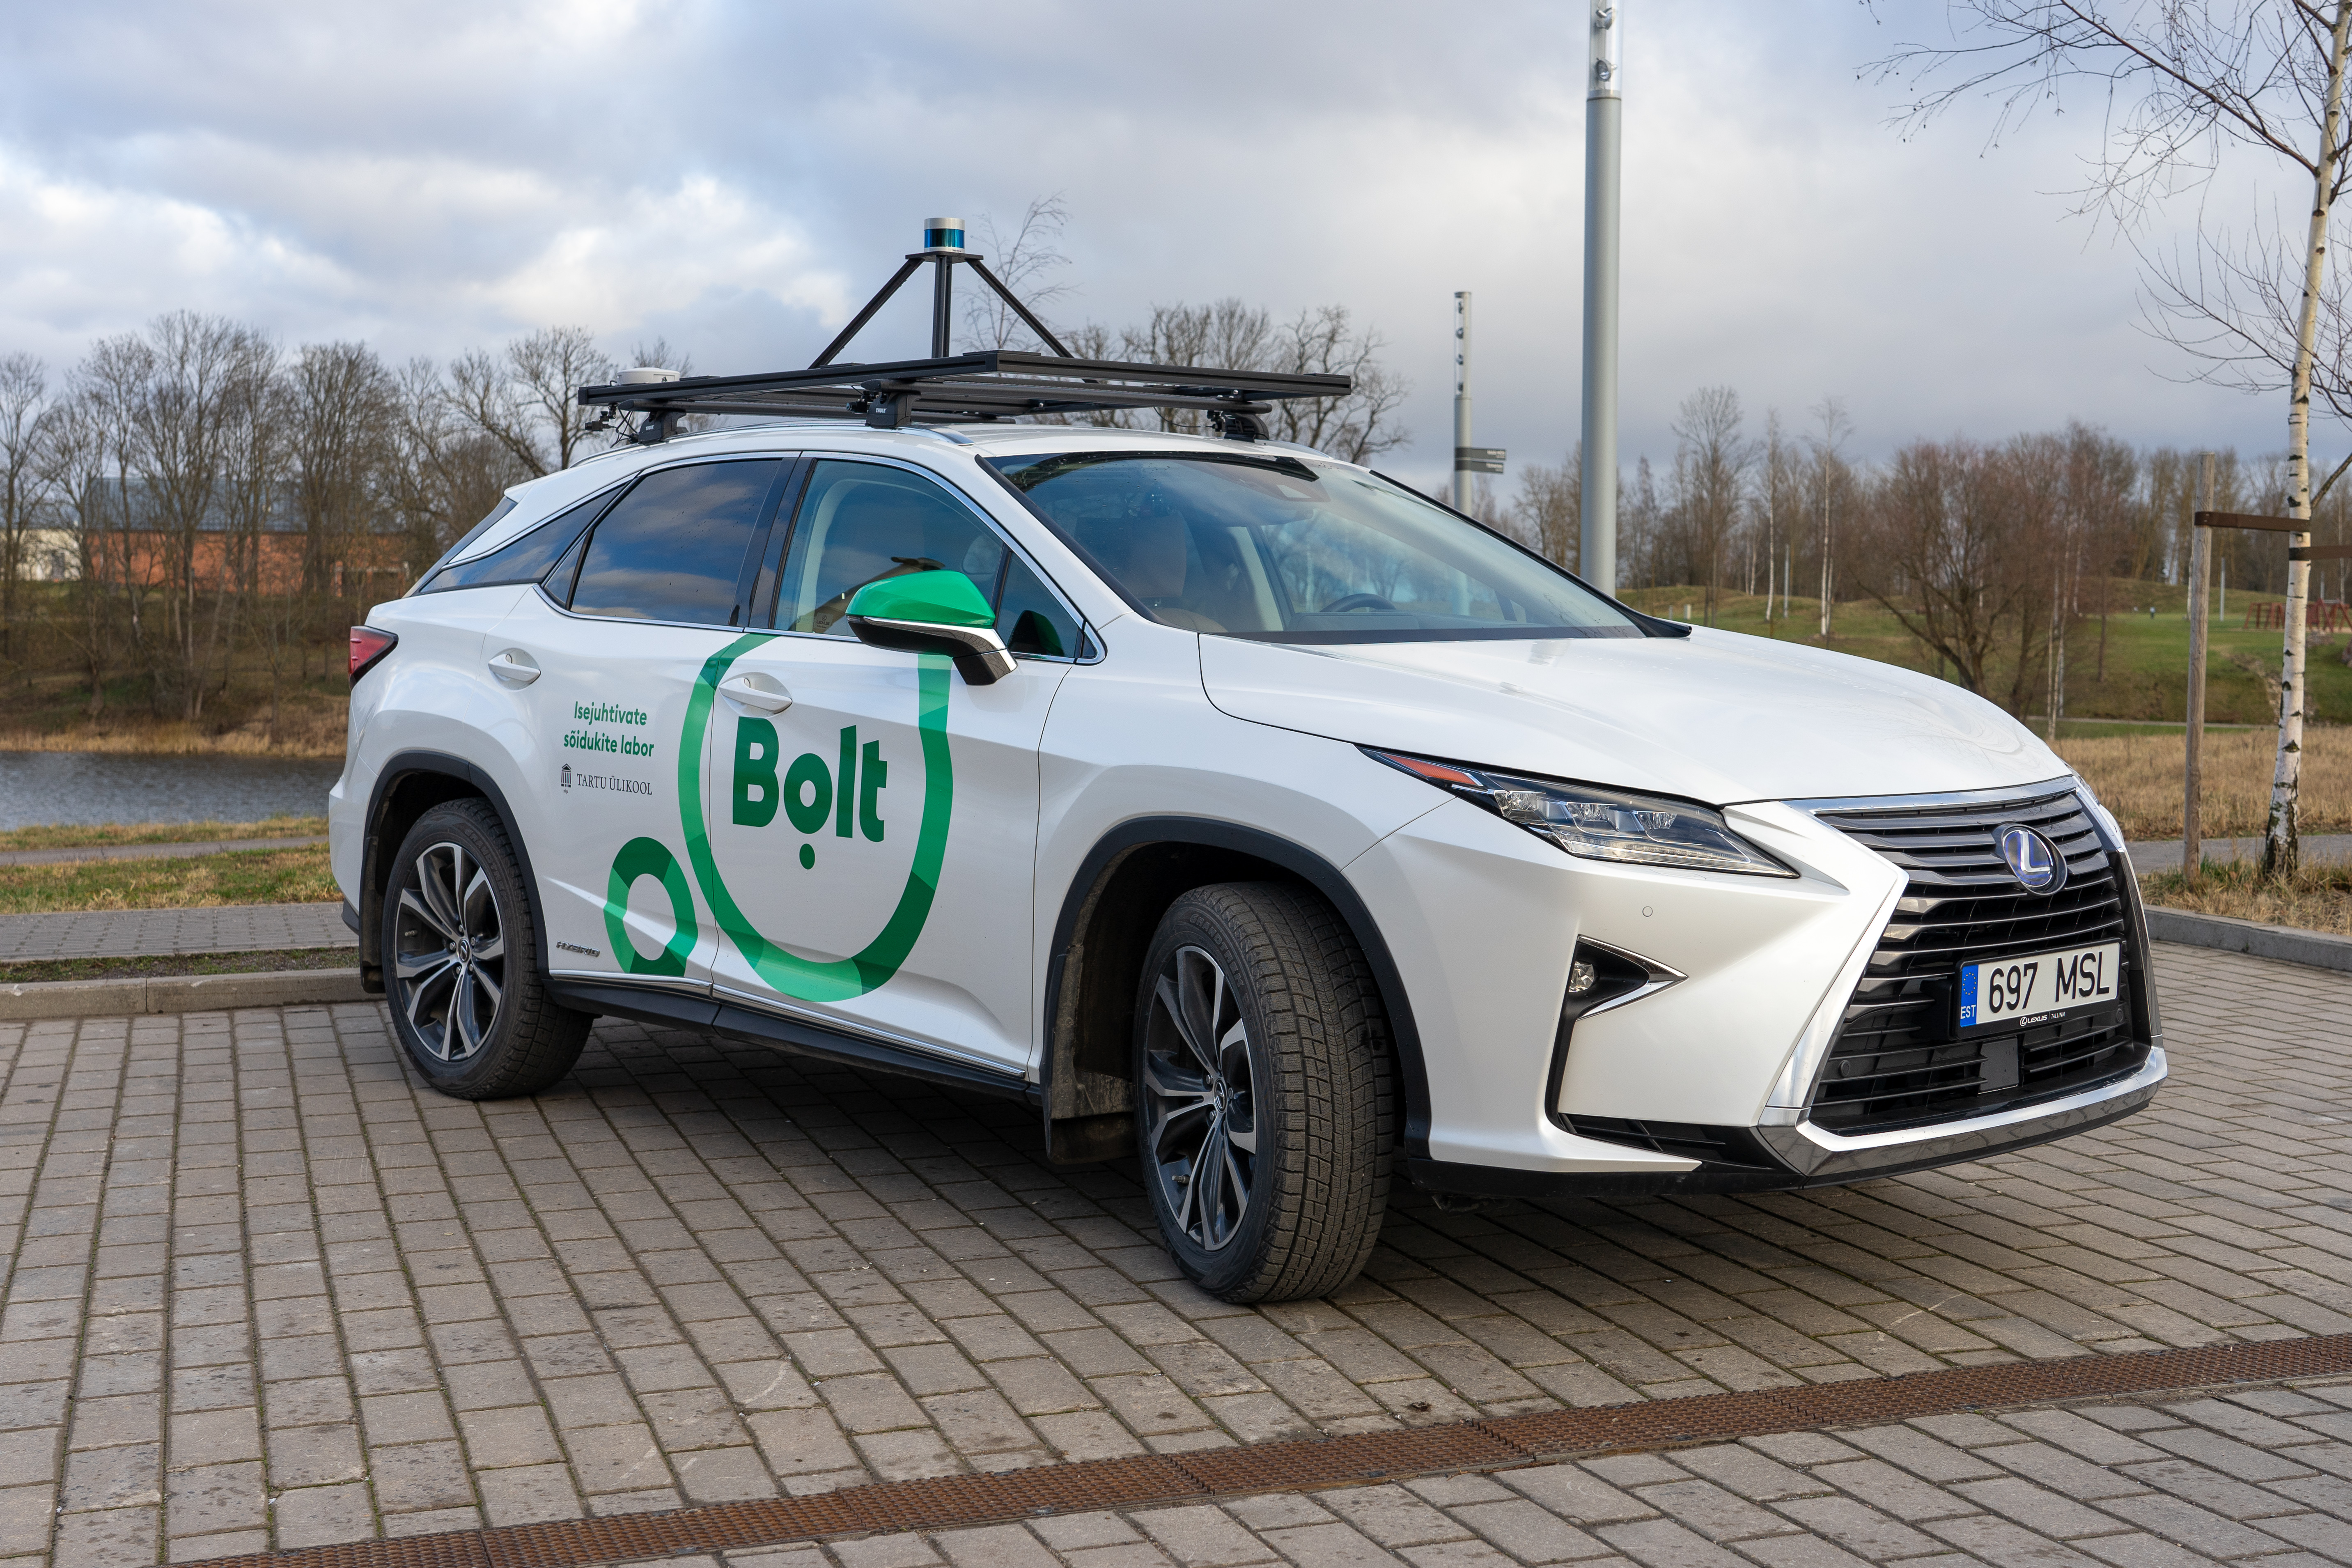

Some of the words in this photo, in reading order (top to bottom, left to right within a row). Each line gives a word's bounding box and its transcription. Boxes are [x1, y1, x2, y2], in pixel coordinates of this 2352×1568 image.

[574, 701, 647, 726] Isejuhtivate
[564, 730, 617, 753] sõidukite
[620, 735, 654, 757] labor
[577, 774, 607, 789] TARTU
[609, 775, 653, 795] ÜLIKOOL
[733, 716, 888, 870] Bolt
[556, 940, 600, 957] HYBRID
[1190, 914, 1244, 987] GRANDTREK
[1989, 961, 2038, 1013] 697
[2055, 951, 2110, 1002] MSL
[1961, 1004, 1976, 1019] EST
[2027, 1015, 2047, 1023] LEXUS
